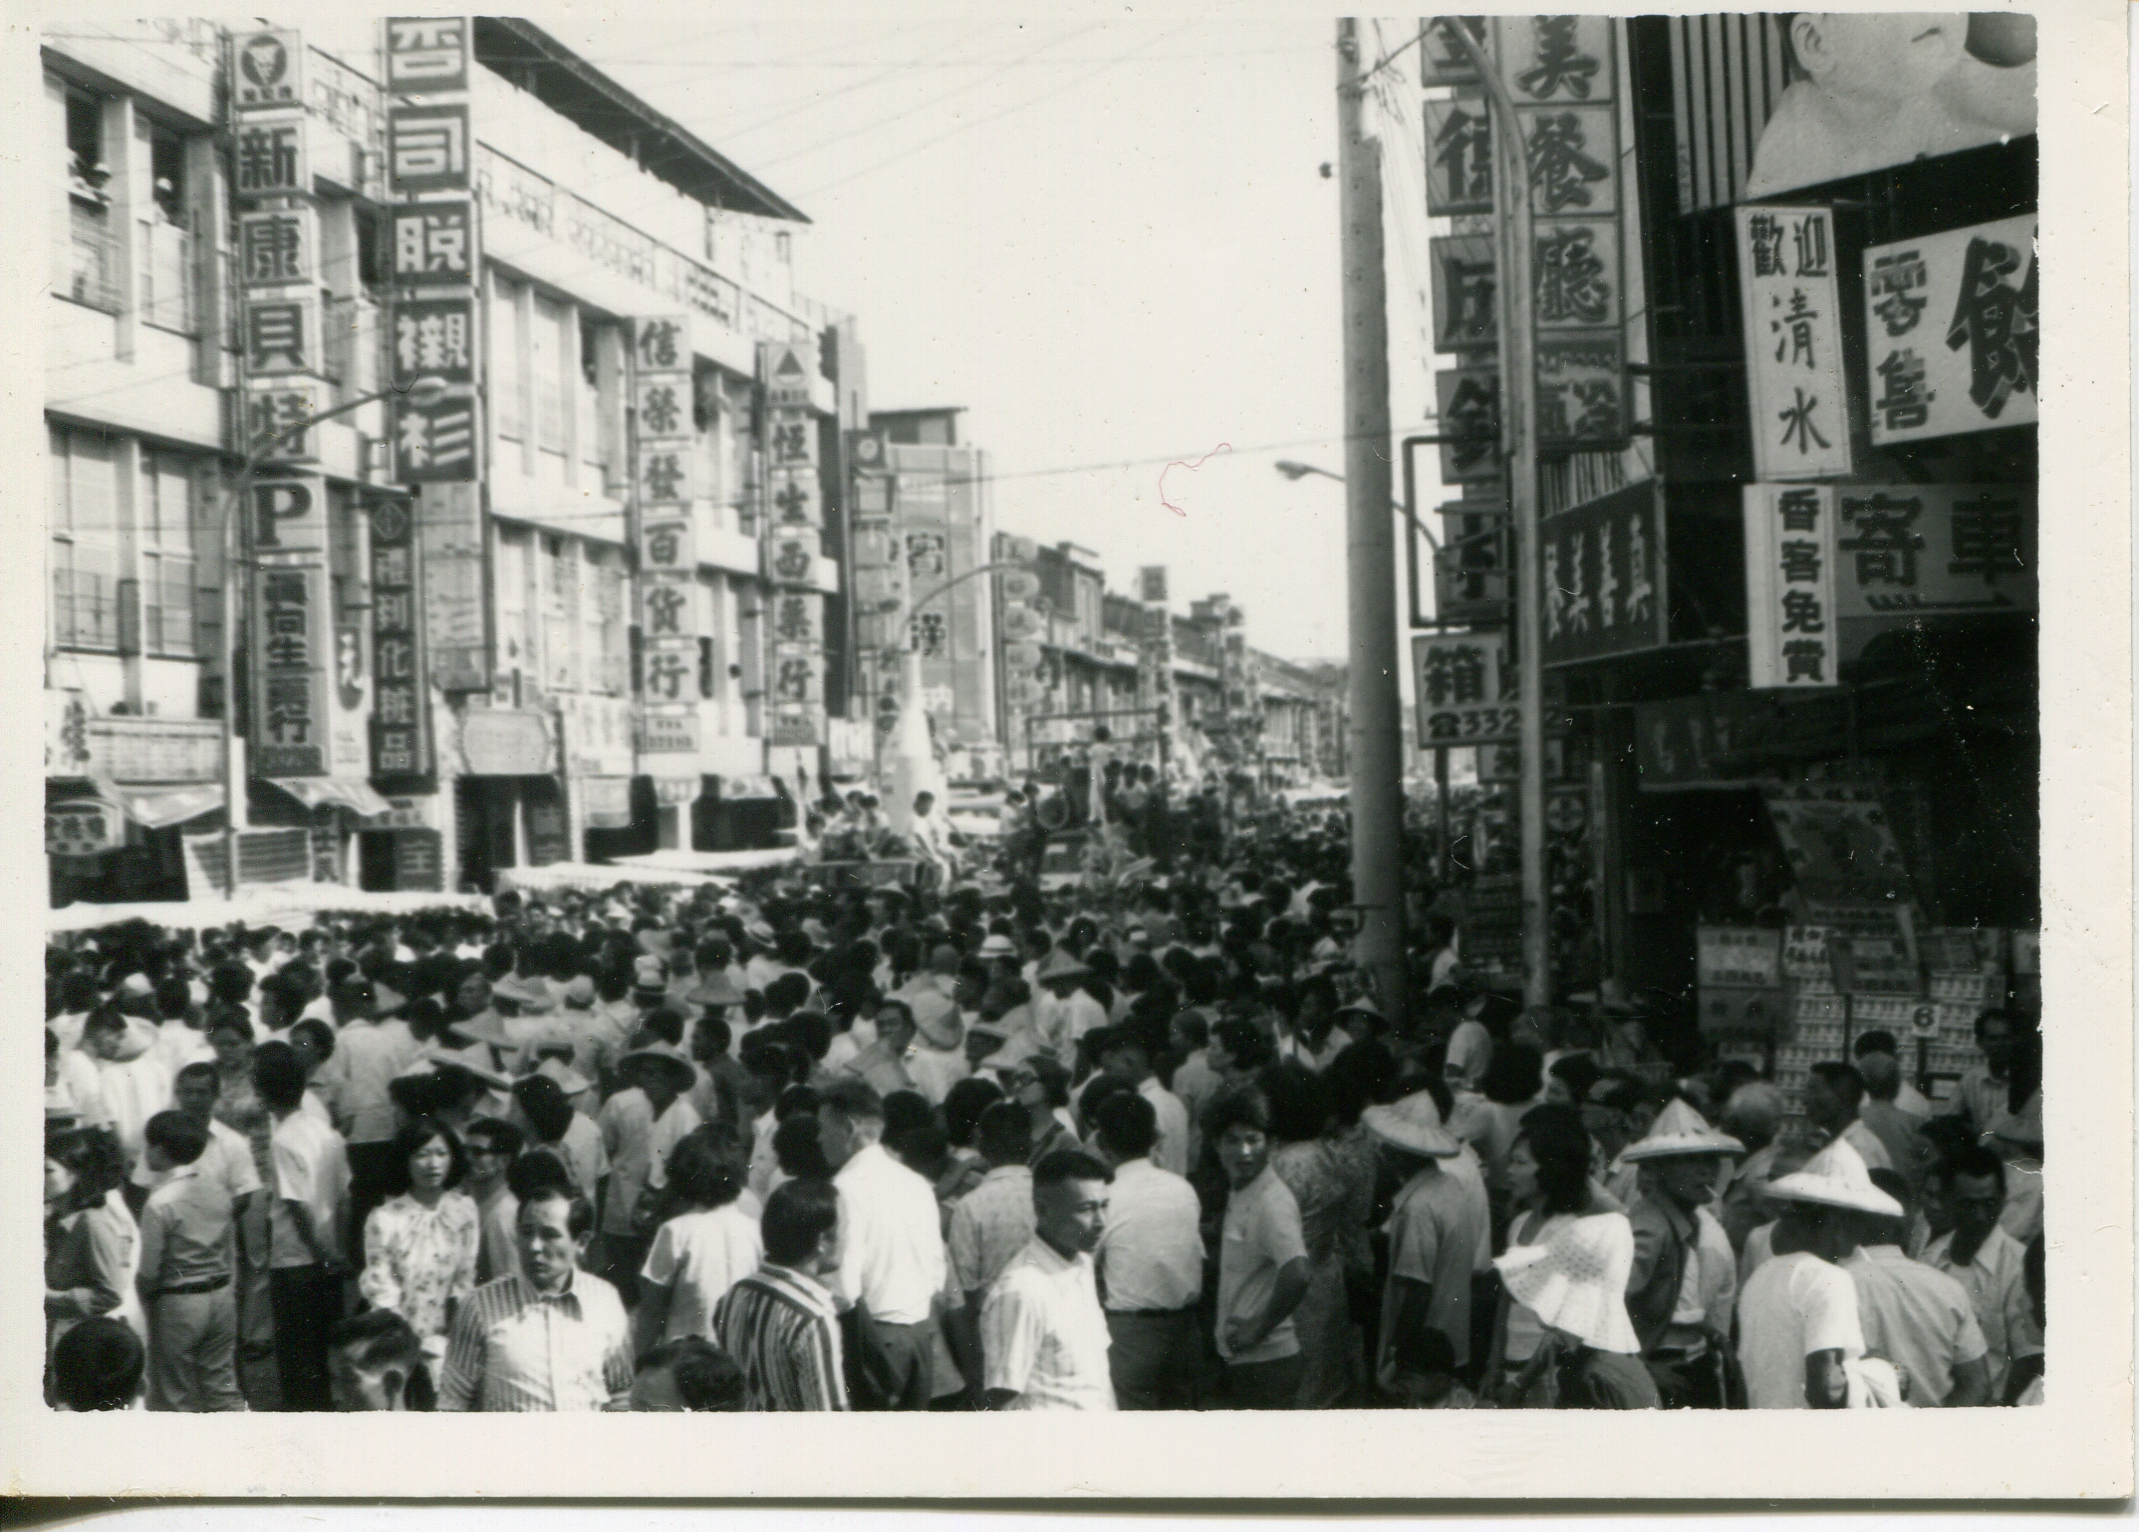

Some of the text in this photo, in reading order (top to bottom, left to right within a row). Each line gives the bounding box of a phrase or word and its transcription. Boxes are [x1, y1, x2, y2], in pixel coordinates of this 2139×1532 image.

[1748, 213, 1829, 279] 歡迎
[1771, 287, 1831, 455] 清水
[1870, 249, 1936, 431] 零售
[1460, 706, 1561, 738] 3322
[1912, 1005, 1935, 1030] 6
